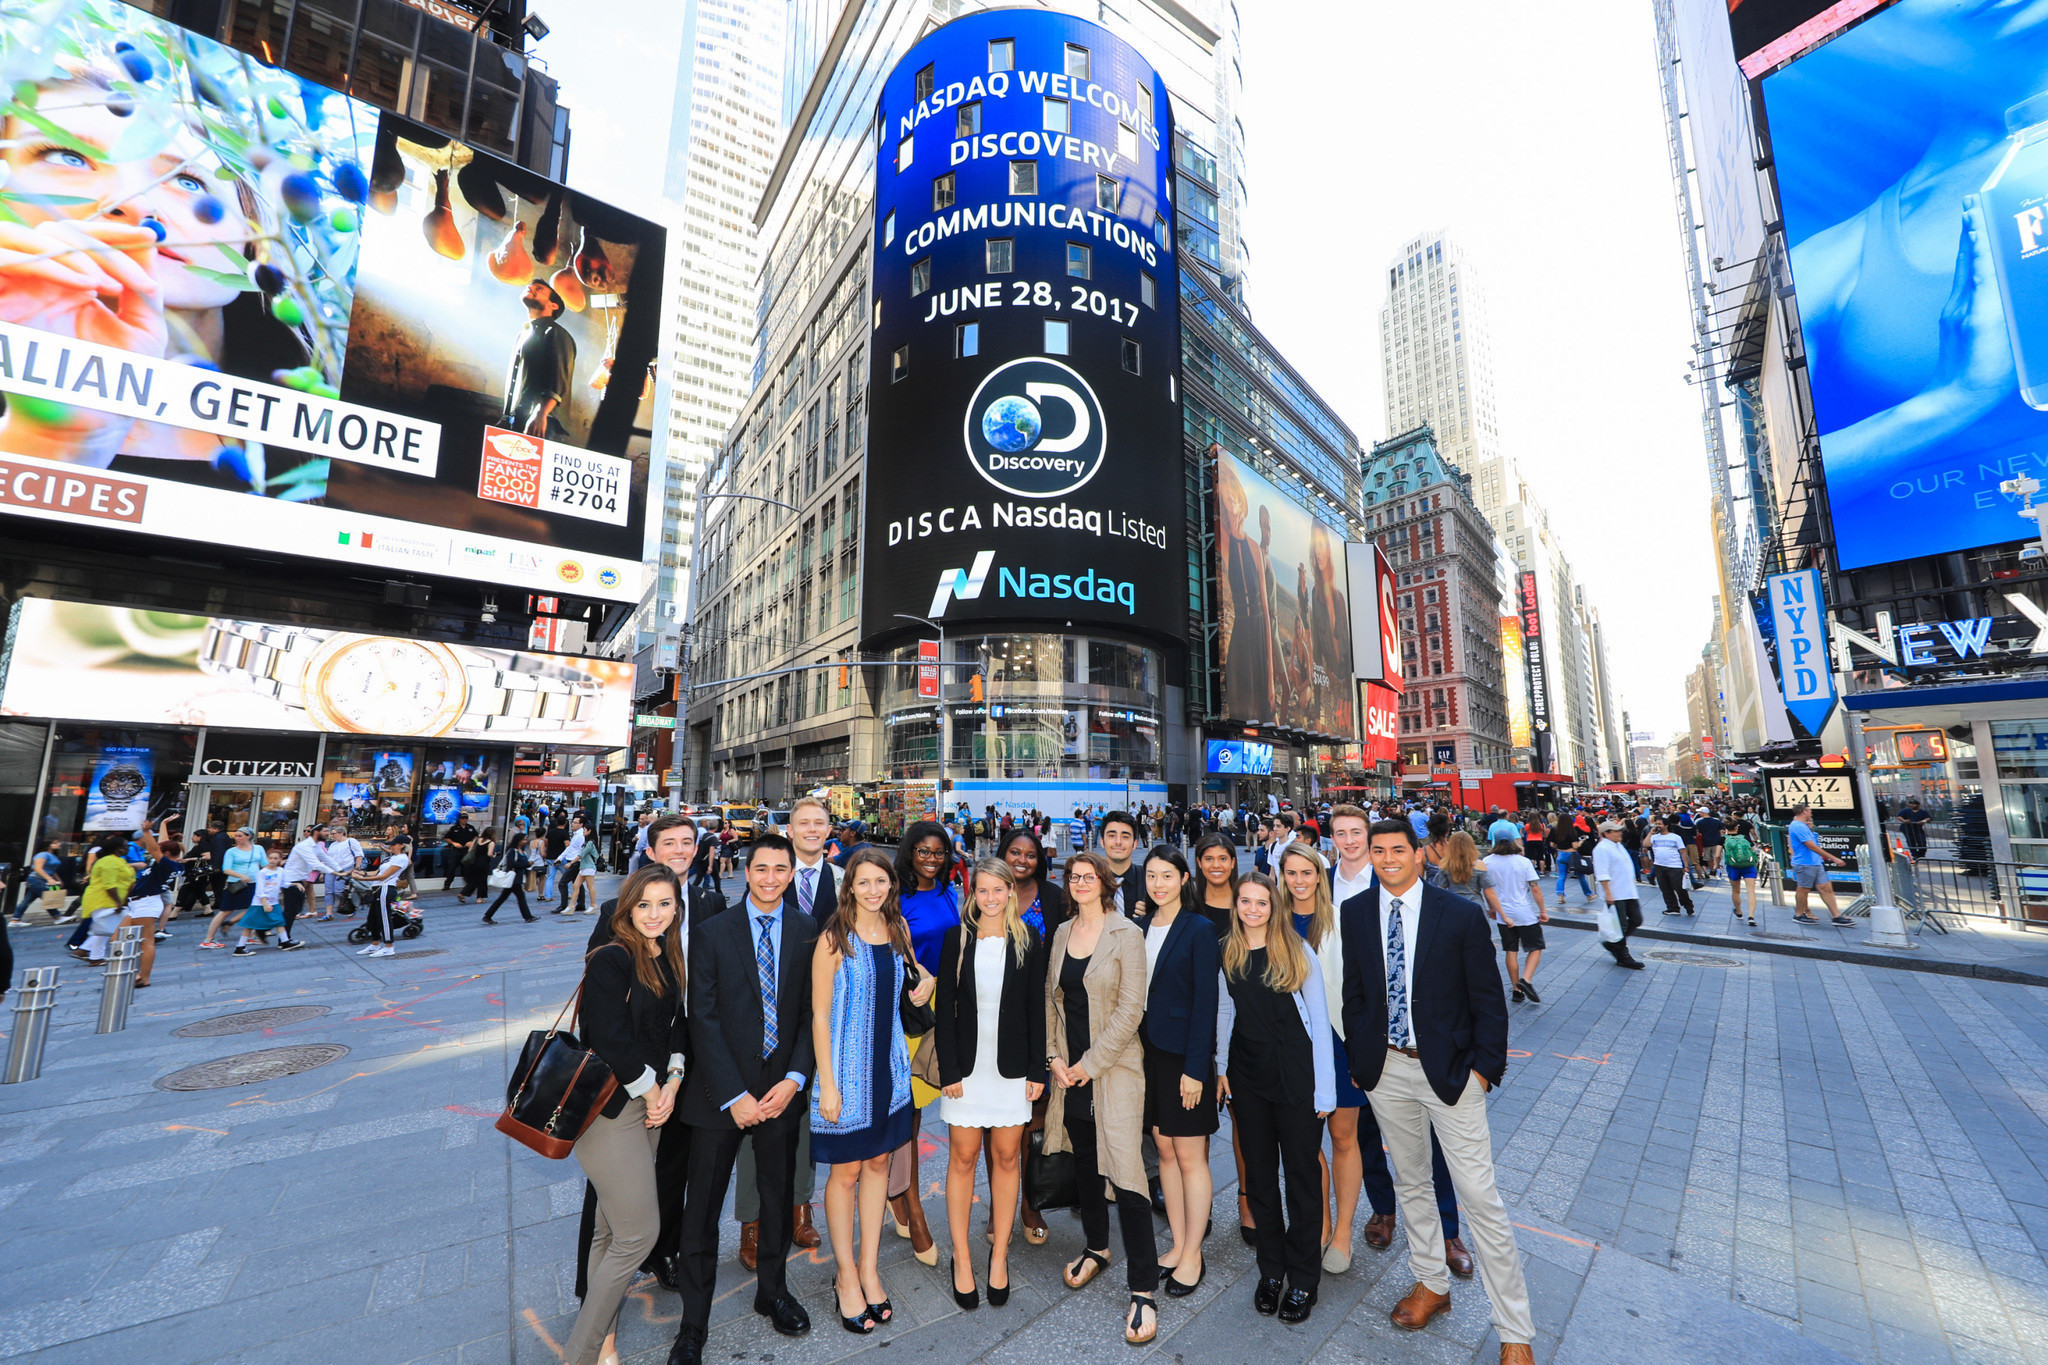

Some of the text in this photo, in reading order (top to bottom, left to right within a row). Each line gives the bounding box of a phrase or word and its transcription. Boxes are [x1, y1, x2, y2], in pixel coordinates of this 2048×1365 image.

[900, 71, 1160, 151] NASDAQ WELCOMES
[950, 131, 1117, 174] DISCOVERY
[905, 202, 1157, 267] COMMUNICATIONS
[924, 281, 1139, 327] JUNE 28, 2017
[190, 381, 281, 432] GET
[293, 402, 423, 464] MORE
[485, 461, 538, 482] FANCY
[486, 455, 526, 468] PRESENTS
[553, 453, 621, 478] FIND US AT
[482, 485, 534, 504] SHOW
[485, 472, 536, 493] FOOD
[553, 467, 618, 495] BOOTH
[1890, 470, 1966, 498] OUR
[551, 486, 617, 513] #2704
[993, 502, 1102, 536] Nasdaq
[1108, 510, 1166, 549] Listed
[999, 567, 1135, 615] Nasdaq
[1523, 574, 1540, 637] Foot Locker
[1780, 576, 1818, 697] NYPD
[1832, 611, 1993, 671] NEW
[638, 716, 674, 727] BROADWAY
[1368, 706, 1396, 739] SALE
[1437, 750, 1451, 759] GAP
[1929, 736, 1945, 757] 5
[202, 758, 314, 777] CITIZEN
[1774, 778, 1840, 793] JAY:Z
[1005, 801, 1036, 809] Nasdaq
